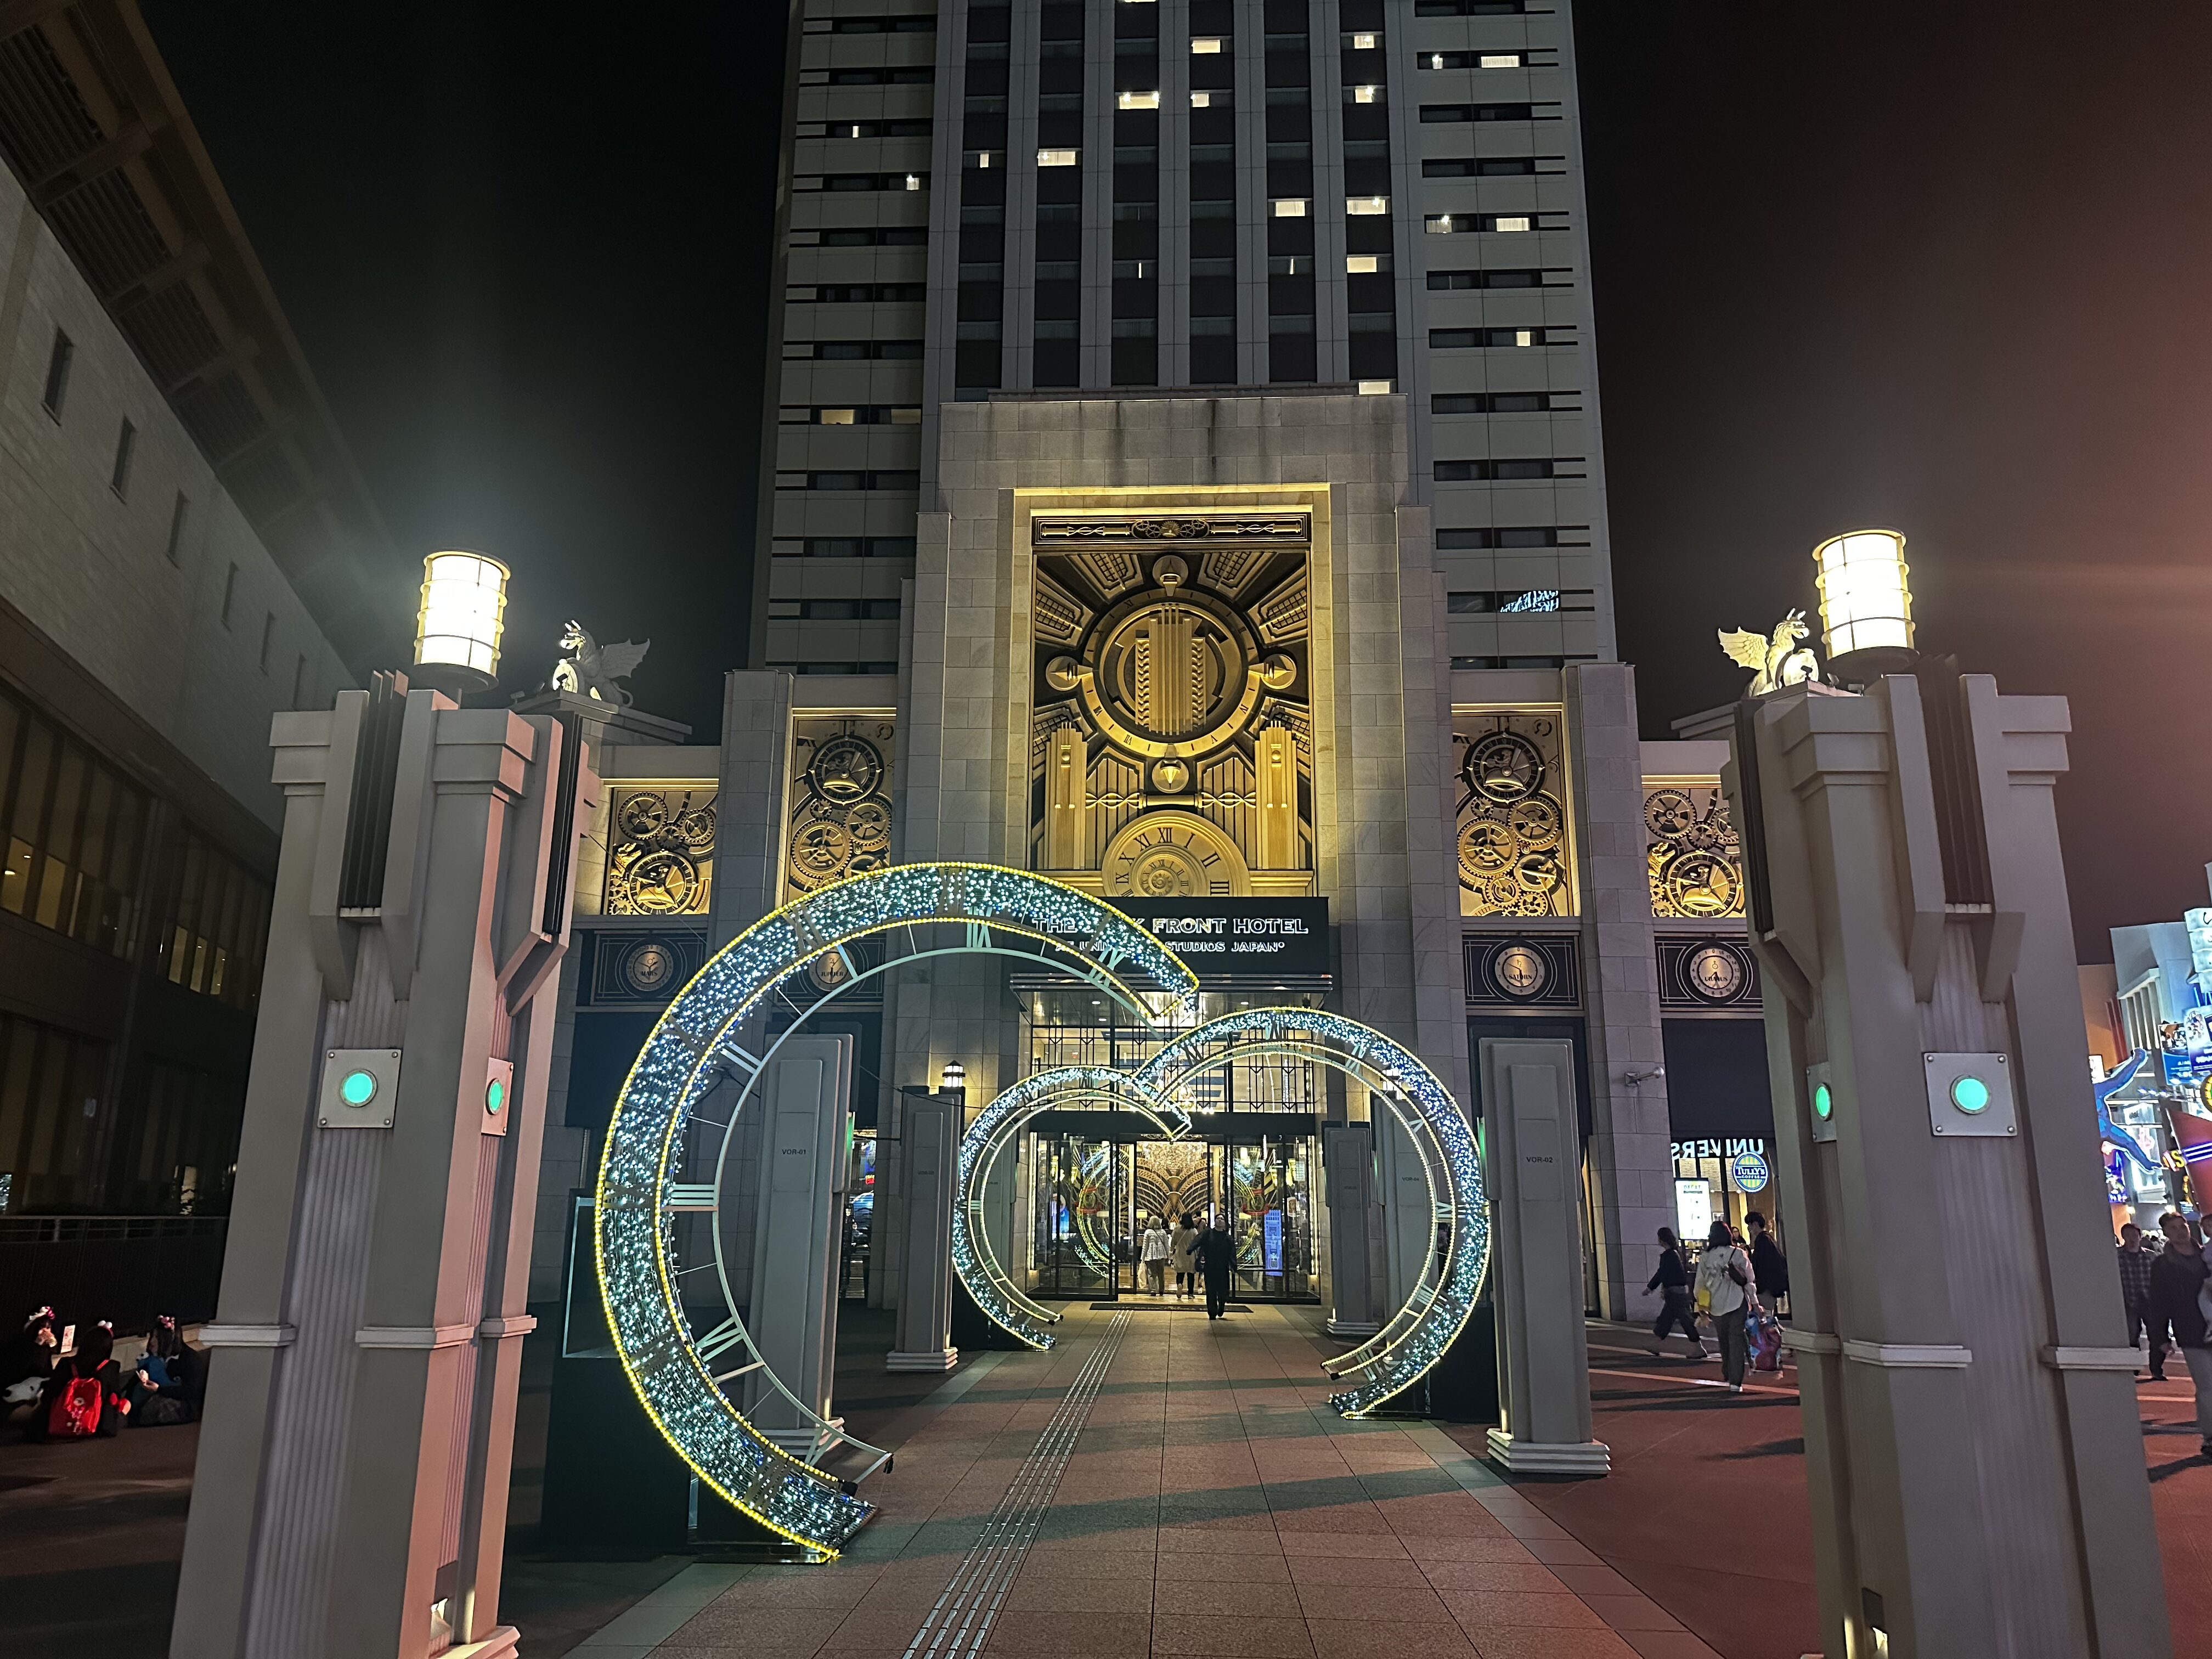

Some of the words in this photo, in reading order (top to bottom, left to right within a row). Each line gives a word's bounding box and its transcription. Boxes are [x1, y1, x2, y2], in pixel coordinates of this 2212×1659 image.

[1133, 832, 1152, 851] XI
[1157, 827, 1172, 843] XII
[1184, 832, 1195, 849] I
[1119, 851, 1135, 866] X
[1201, 851, 1221, 869] II
[1115, 872, 1129, 884] IX
[1210, 879, 1229, 896] III
[1153, 918, 1227, 934] FRONT
[1233, 918, 1308, 934] HOTEL
[1165, 941, 1225, 952] STUDIOS
